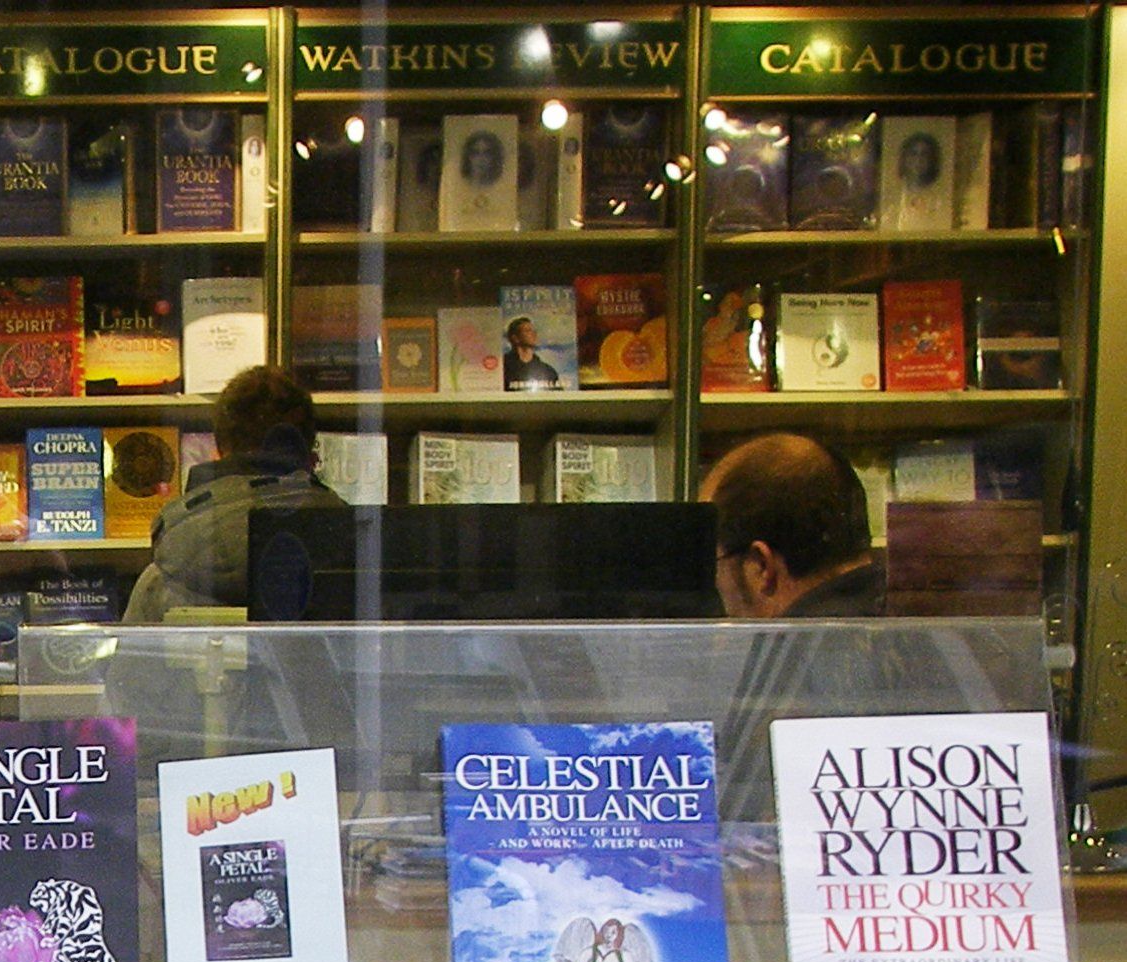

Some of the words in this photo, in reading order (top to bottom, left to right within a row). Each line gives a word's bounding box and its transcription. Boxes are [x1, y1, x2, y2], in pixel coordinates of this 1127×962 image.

[299, 43, 496, 72] WATKINS
[760, 42, 1049, 74] CATALOGUE
[4, 175, 47, 191] BOOK
[5, 319, 56, 334] SPIRIT
[99, 308, 155, 330] Light
[34, 441, 97, 454] CHOPRA
[31, 463, 101, 475] SUPER
[32, 477, 99, 490] BRAIN
[51, 520, 97, 533] TANZI
[33, 592, 108, 605] Possibilities
[455, 754, 709, 791] CELESTIAL
[811, 744, 1021, 789] ALISON
[186, 780, 273, 836] New
[467, 793, 702, 822] AMBULANCE
[812, 788, 1028, 830] WYNNE
[541, 827, 586, 836] NOVEL
[590, 827, 607, 836] OF
[612, 827, 642, 836] LIFE
[24, 832, 95, 849] EADE
[498, 839, 527, 848] AND
[222, 848, 278, 862] SINGLE
[814, 829, 1031, 877] RYDER
[220, 862, 269, 876] PETAL
[817, 883, 891, 910] THE
[898, 881, 1032, 914] QUIRKY
[824, 914, 1039, 954] MEDIUM
